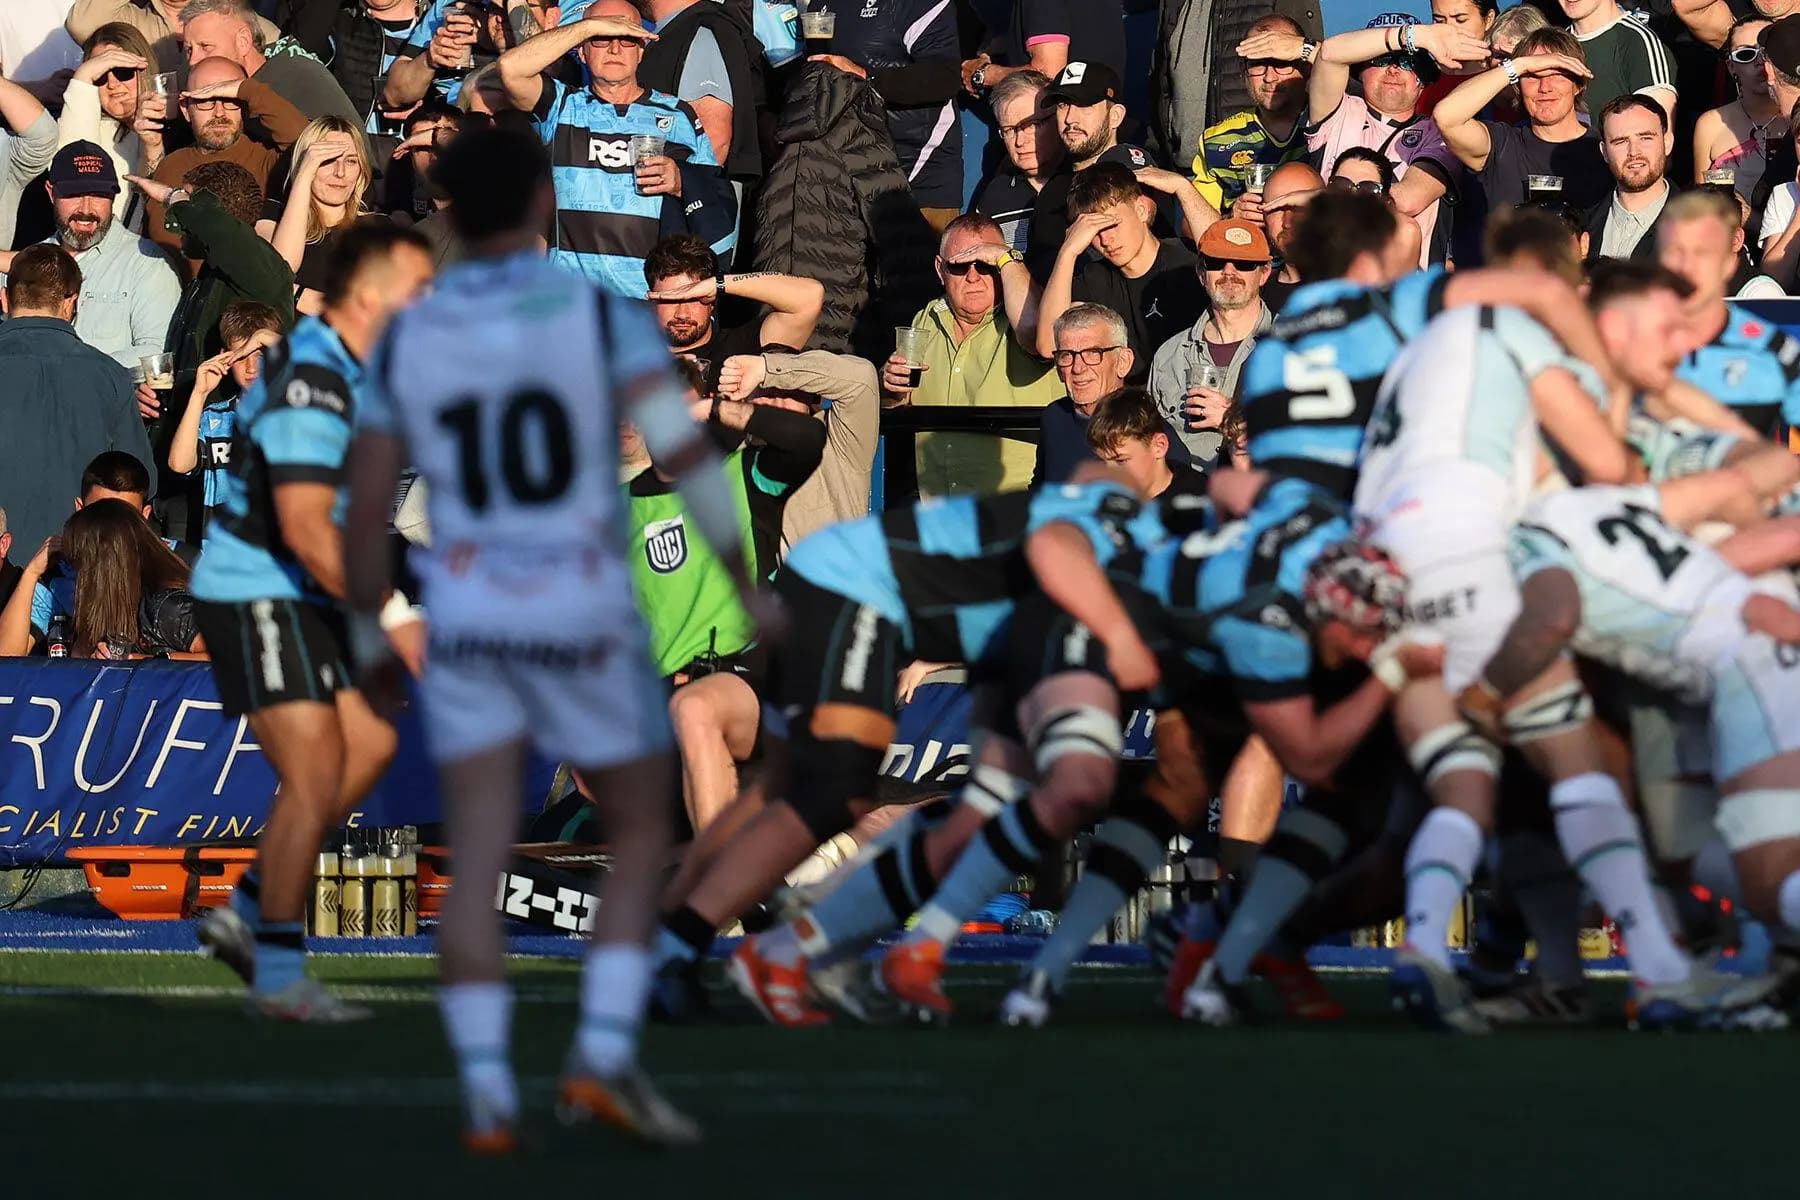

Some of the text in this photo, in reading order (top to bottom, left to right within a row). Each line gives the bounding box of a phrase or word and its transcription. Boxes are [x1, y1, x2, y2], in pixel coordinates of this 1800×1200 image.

[1375, 13, 1405, 26] BLUE
[1283, 345, 1356, 420] 5
[437, 390, 574, 507] 10
